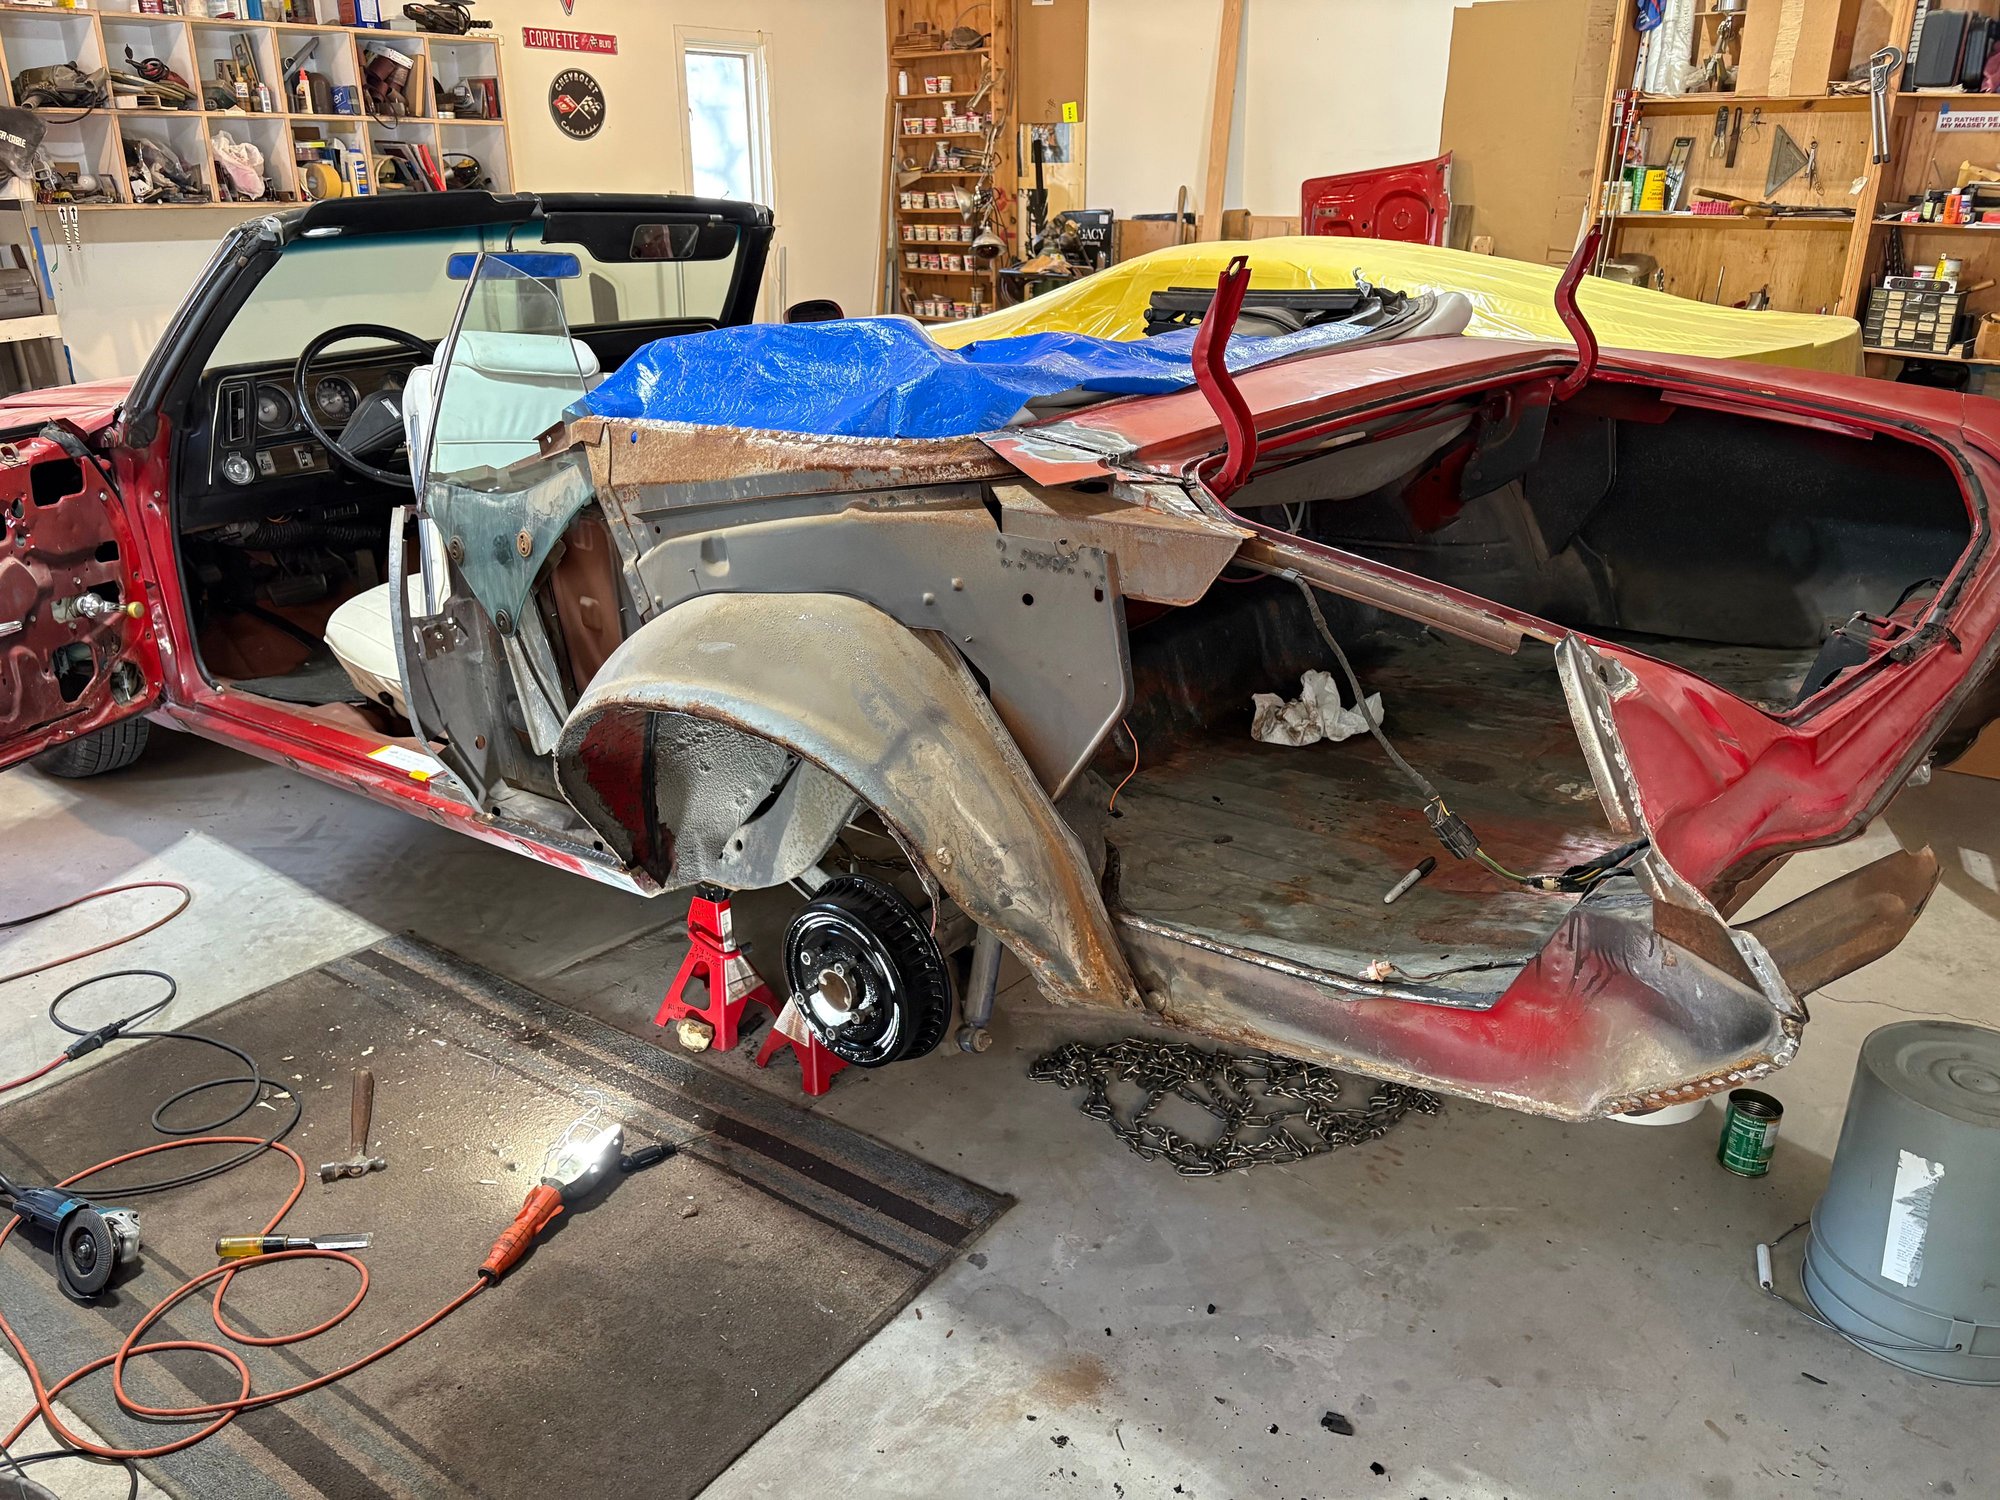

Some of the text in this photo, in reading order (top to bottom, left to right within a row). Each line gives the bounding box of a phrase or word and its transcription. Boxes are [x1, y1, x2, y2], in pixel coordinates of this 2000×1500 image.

[529, 30, 612, 50] CORVETTE BLVD
[1907, 0, 1928, 64] TAURUS
[555, 72, 599, 93] CHEVROLET
